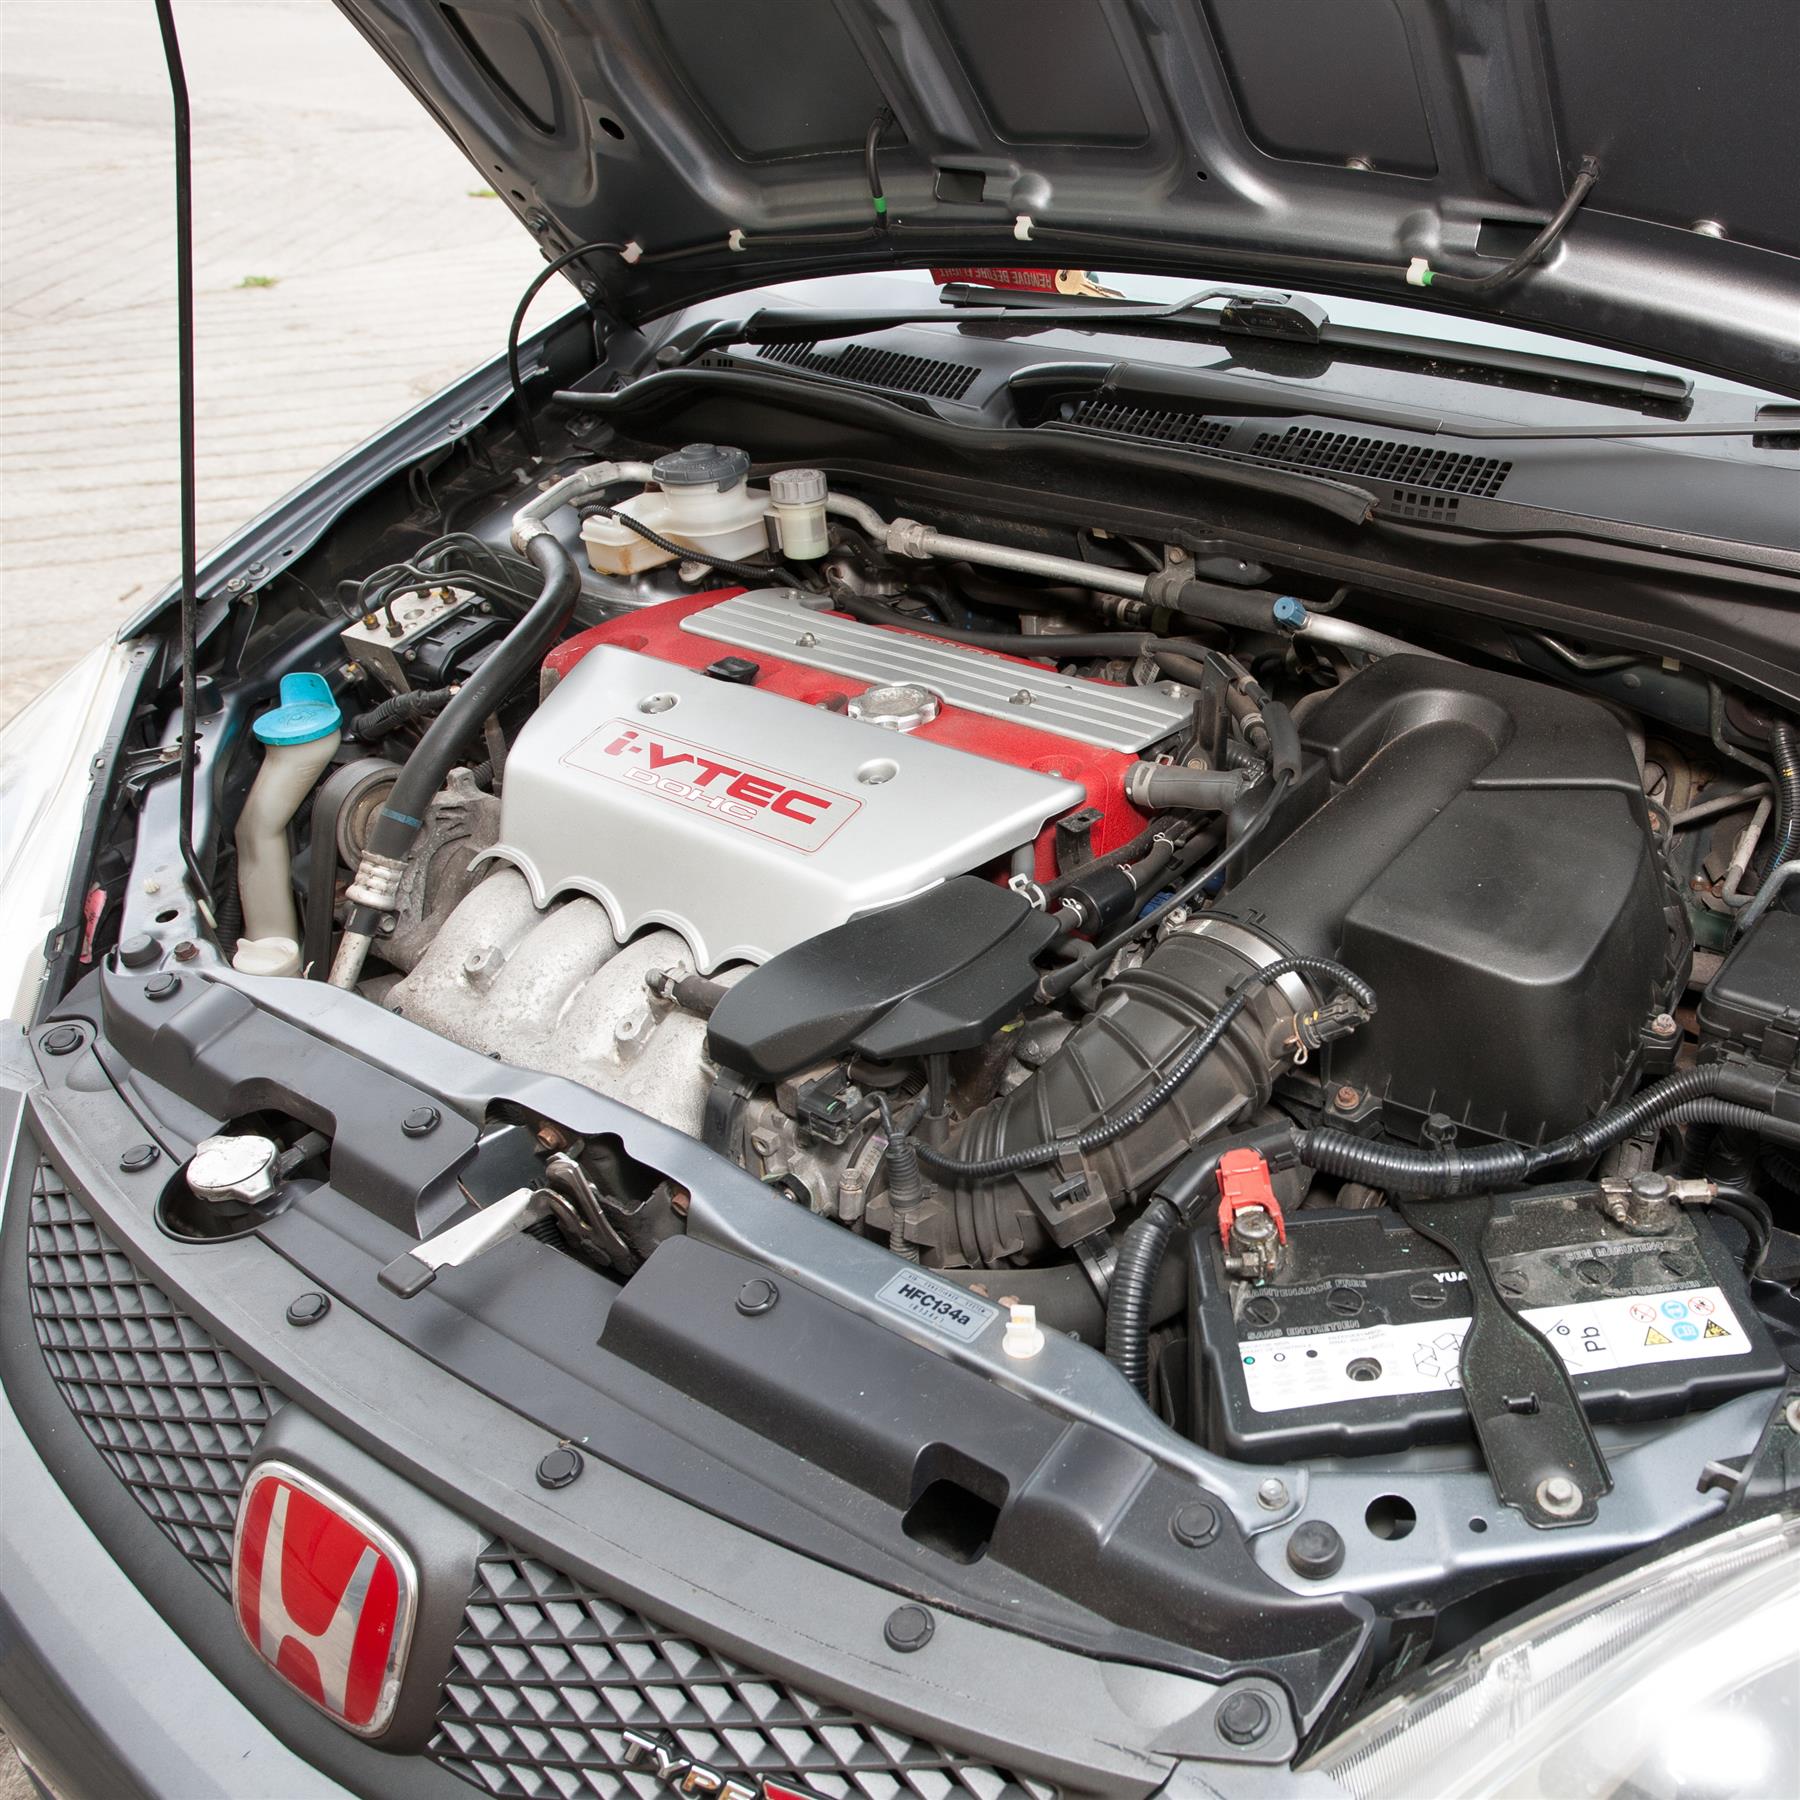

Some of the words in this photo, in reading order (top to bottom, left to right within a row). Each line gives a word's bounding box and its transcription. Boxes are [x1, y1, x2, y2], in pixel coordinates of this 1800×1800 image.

[976, 267, 1010, 284] BEFORE
[1012, 270, 1052, 289] REMOVE
[604, 731, 832, 825] i-VTEC
[623, 766, 758, 821] DOHC
[1335, 1279, 1368, 1289] FREE
[898, 1283, 971, 1326] HFC134a
[1247, 1329, 1284, 1341] SANS
[1286, 1319, 1361, 1337] ENTRETIEN
